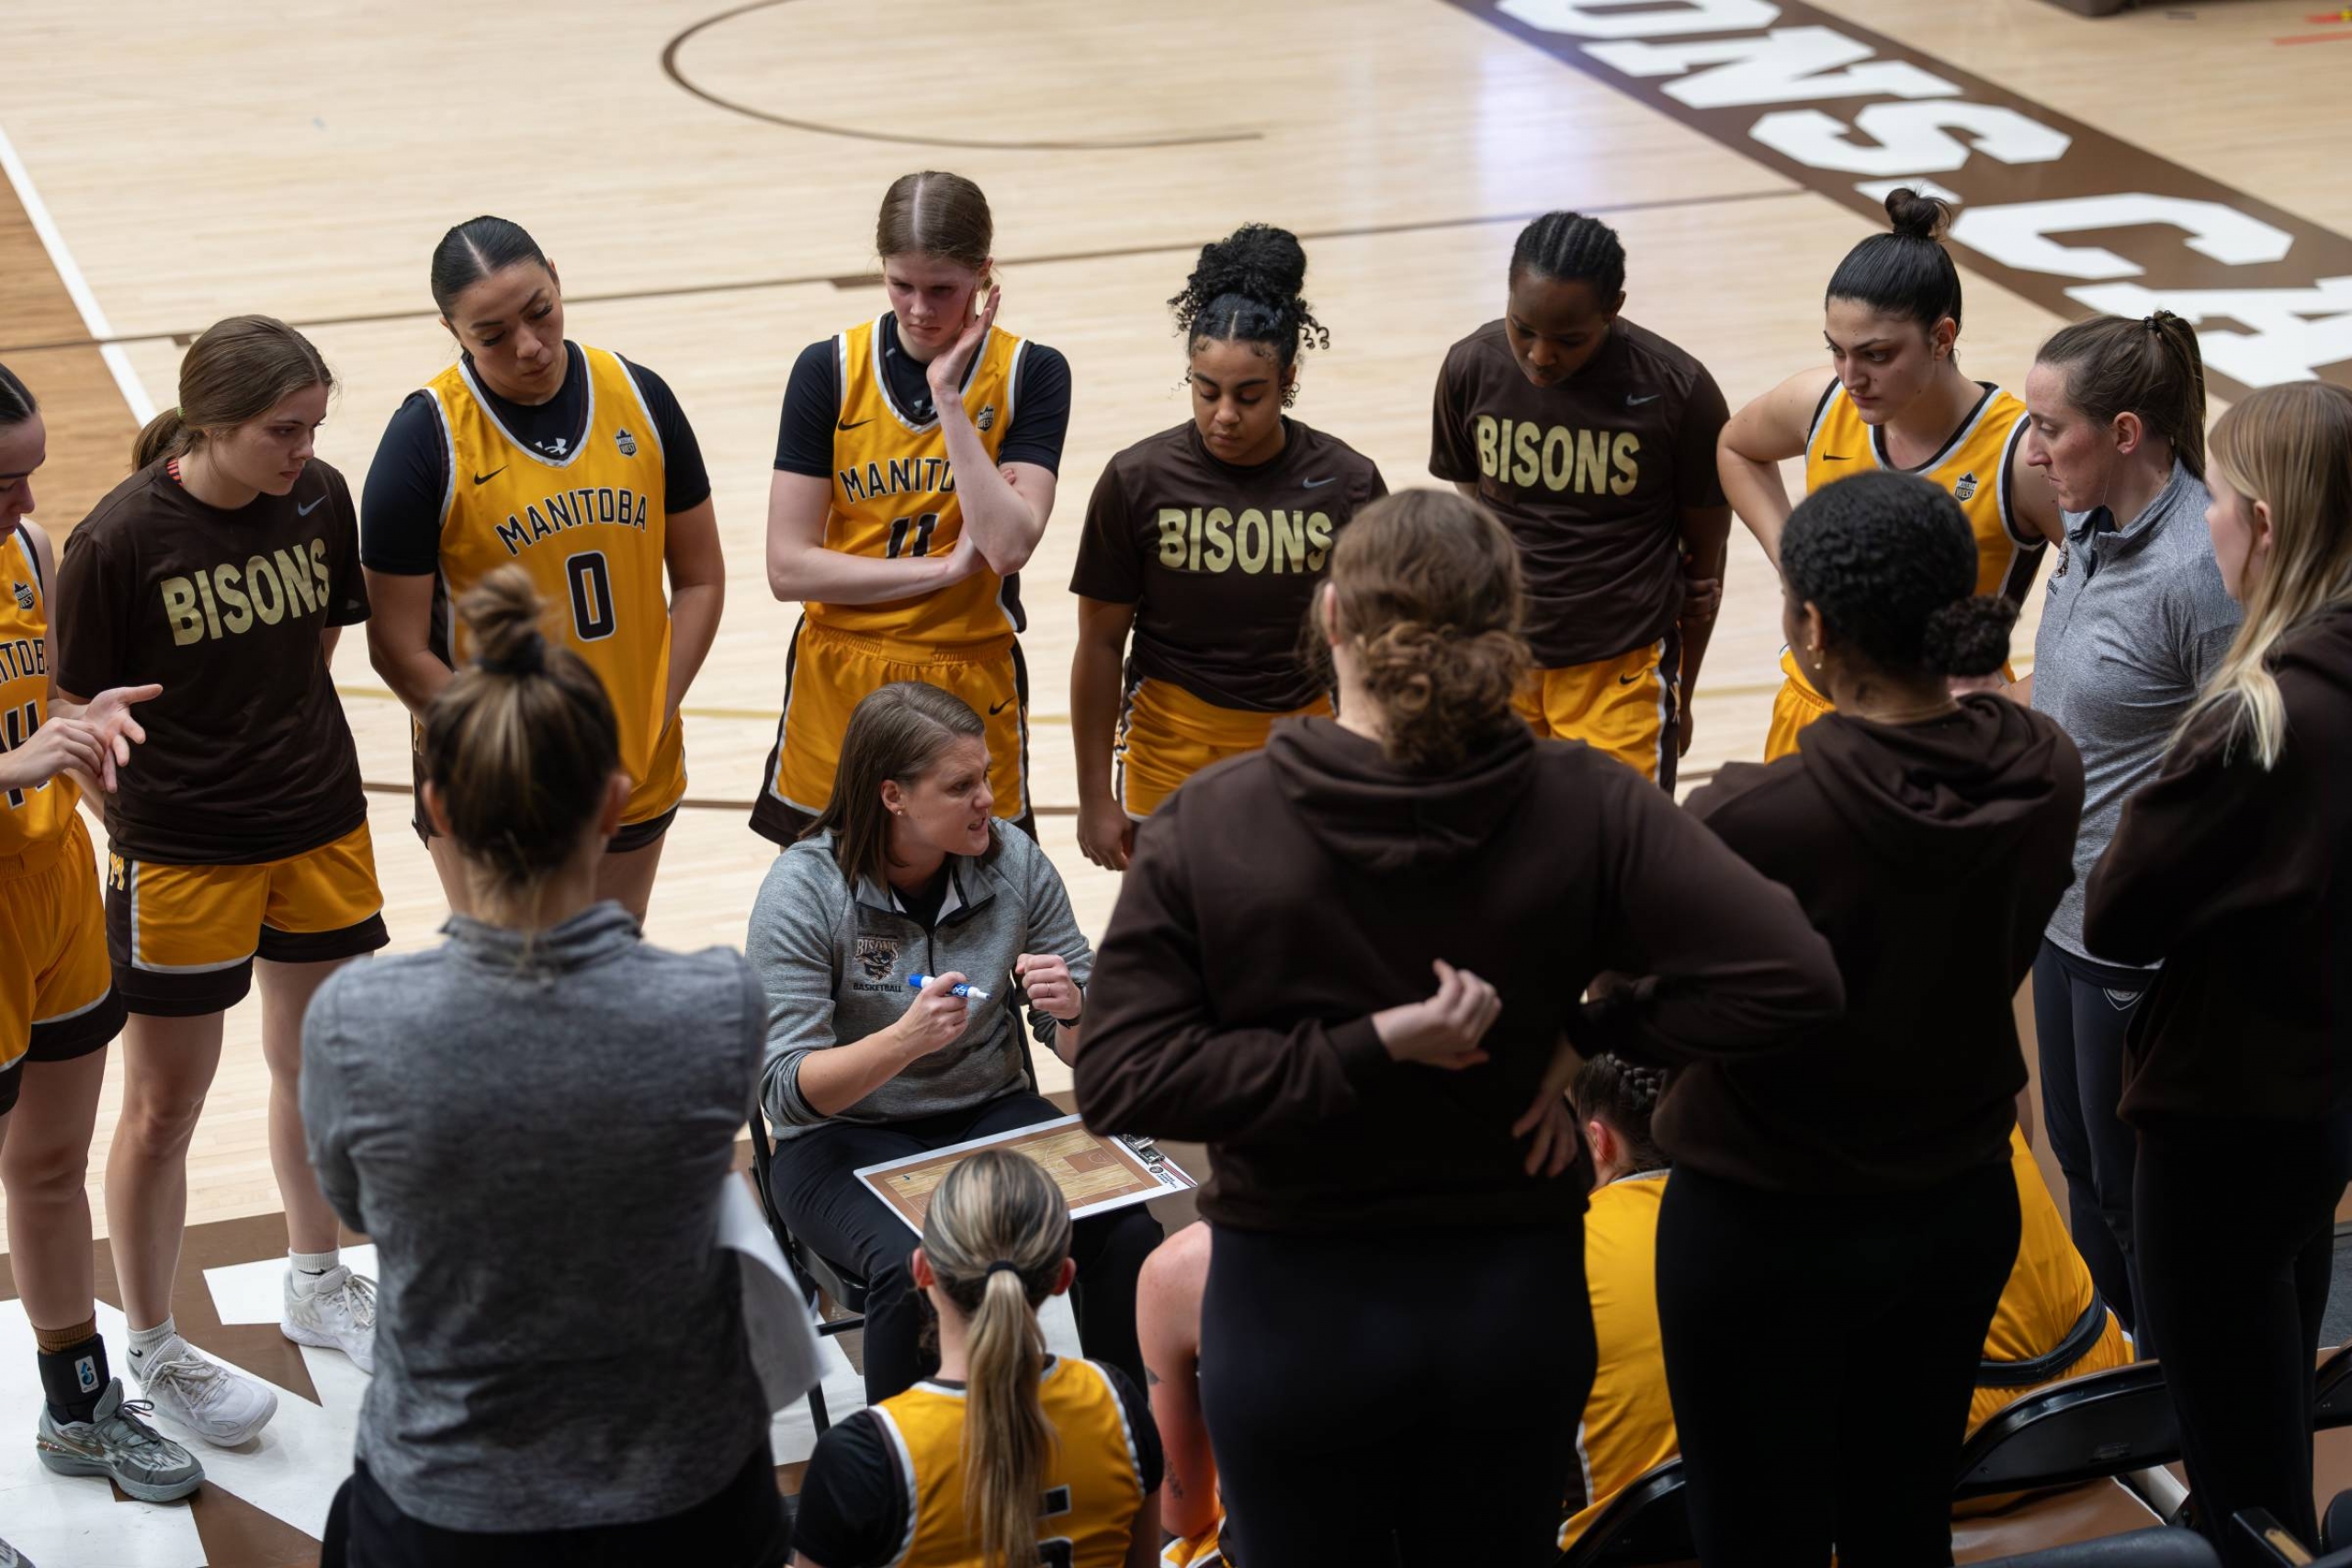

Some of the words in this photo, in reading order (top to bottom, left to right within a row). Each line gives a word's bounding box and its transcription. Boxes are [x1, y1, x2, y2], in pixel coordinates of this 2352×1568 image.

[1476, 414, 1640, 496] BISONS
[494, 488, 647, 557] MANITOBA
[886, 512, 940, 558] 11
[1159, 507, 1332, 574] BISONS
[161, 538, 331, 646] BISONS
[565, 550, 616, 642] 0
[853, 982, 901, 993] BASKETBALL
